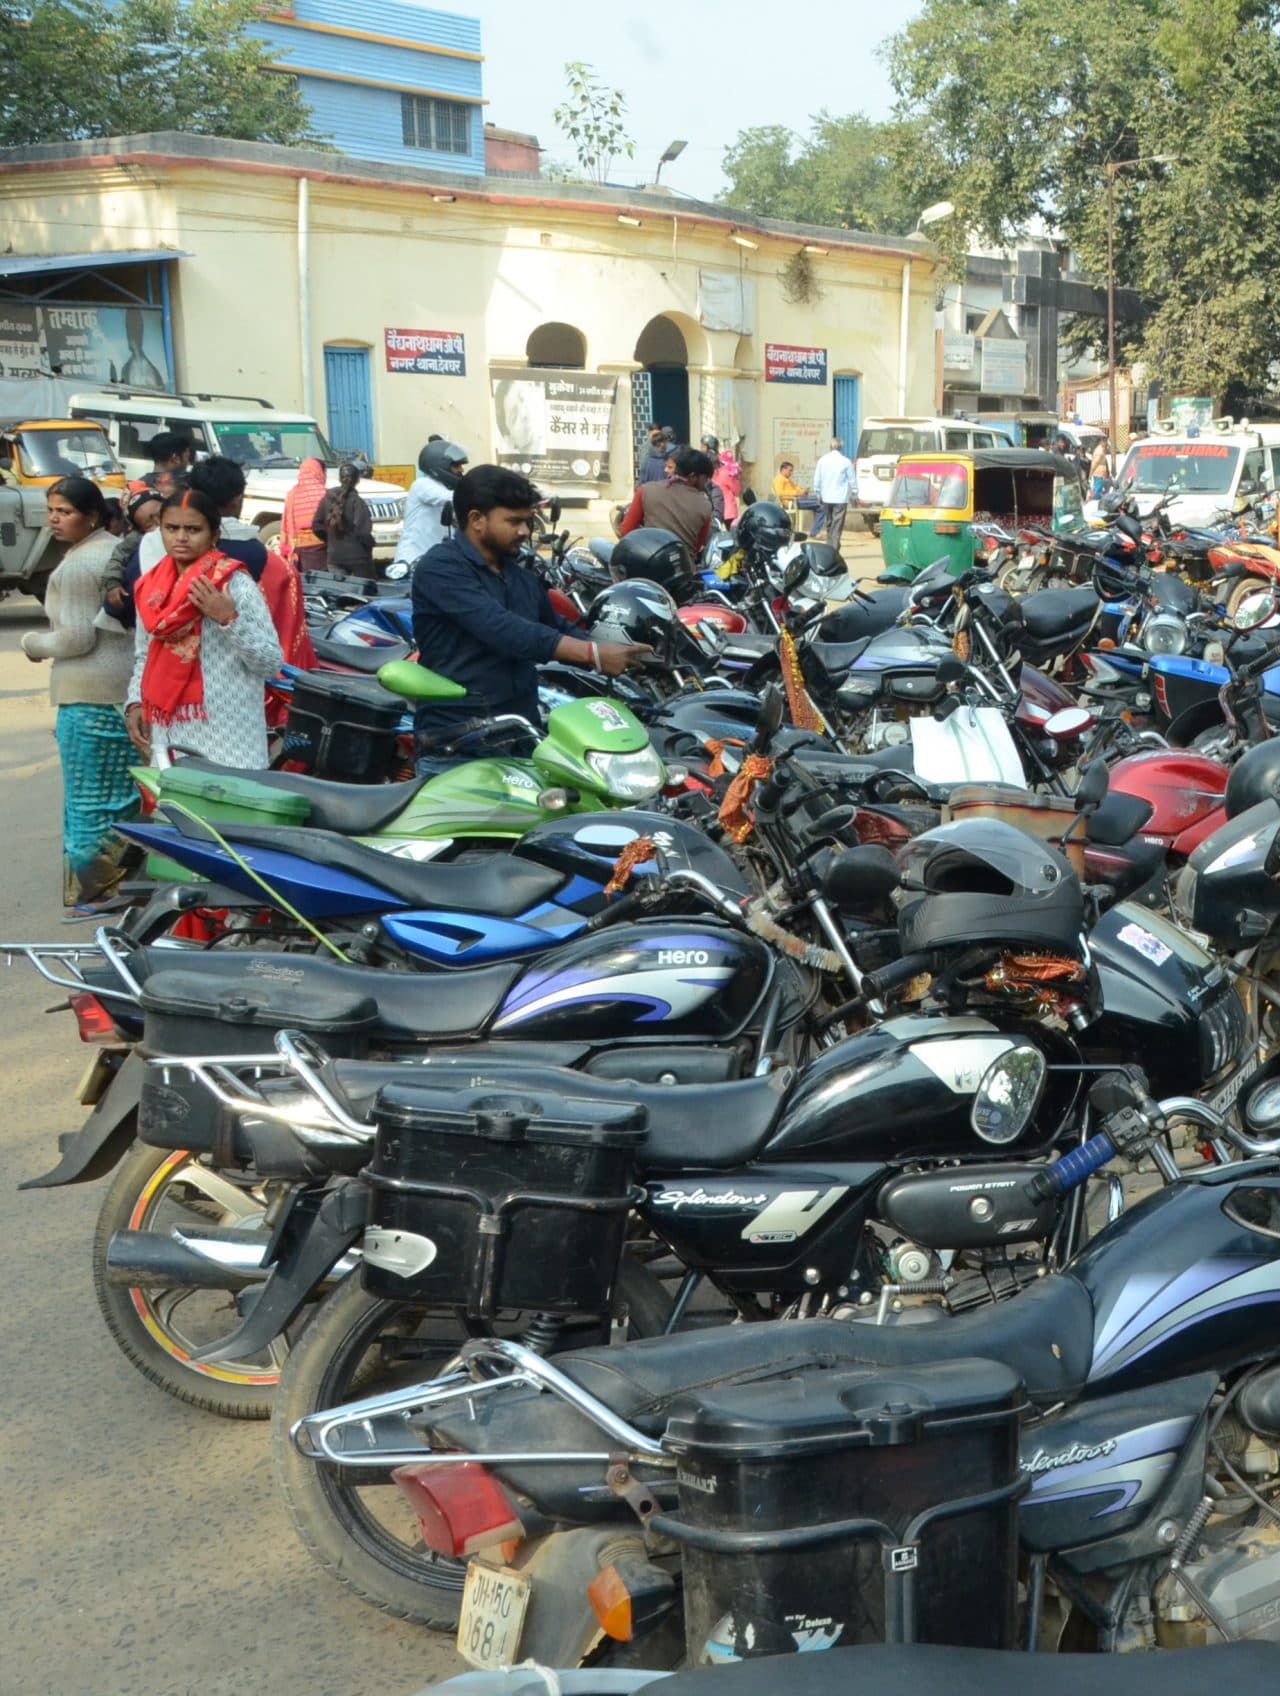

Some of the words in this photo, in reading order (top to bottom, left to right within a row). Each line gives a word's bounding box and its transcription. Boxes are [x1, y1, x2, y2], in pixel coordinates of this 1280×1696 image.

[389, 357, 416, 371] नगर
[548, 380, 574, 395] मुकेश
[550, 416, 577, 435] कैंसर
[580, 417, 589, 435] से
[502, 774, 534, 789] Hero
[657, 950, 709, 965] Hero
[950, 1184, 983, 1192] POWER
[985, 1181, 1016, 1189] START
[805, 1616, 832, 1629] Deluxe
